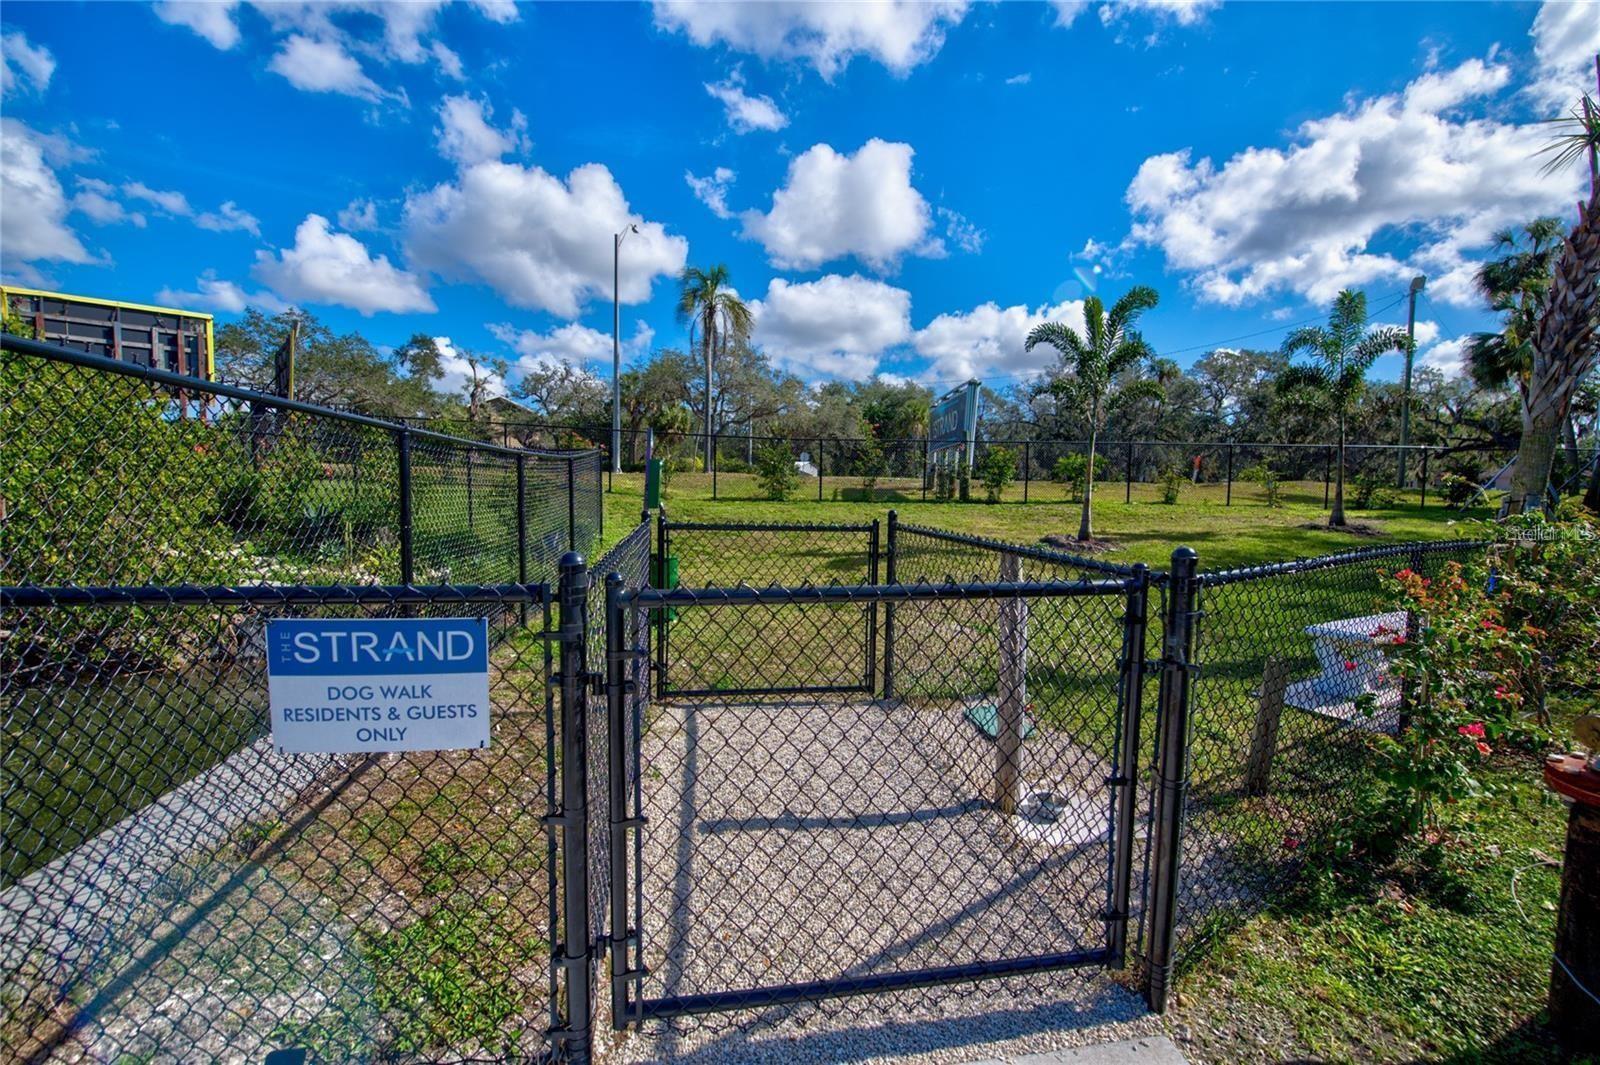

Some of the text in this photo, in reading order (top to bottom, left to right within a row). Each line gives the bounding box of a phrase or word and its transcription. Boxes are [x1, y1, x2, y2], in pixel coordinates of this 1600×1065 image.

[280, 632, 291, 663] THE
[294, 630, 475, 663] STRAND
[327, 685, 432, 701] DOG WALK
[283, 704, 477, 722] RESIDENTS & GUESTS
[356, 727, 407, 742] ONLY
